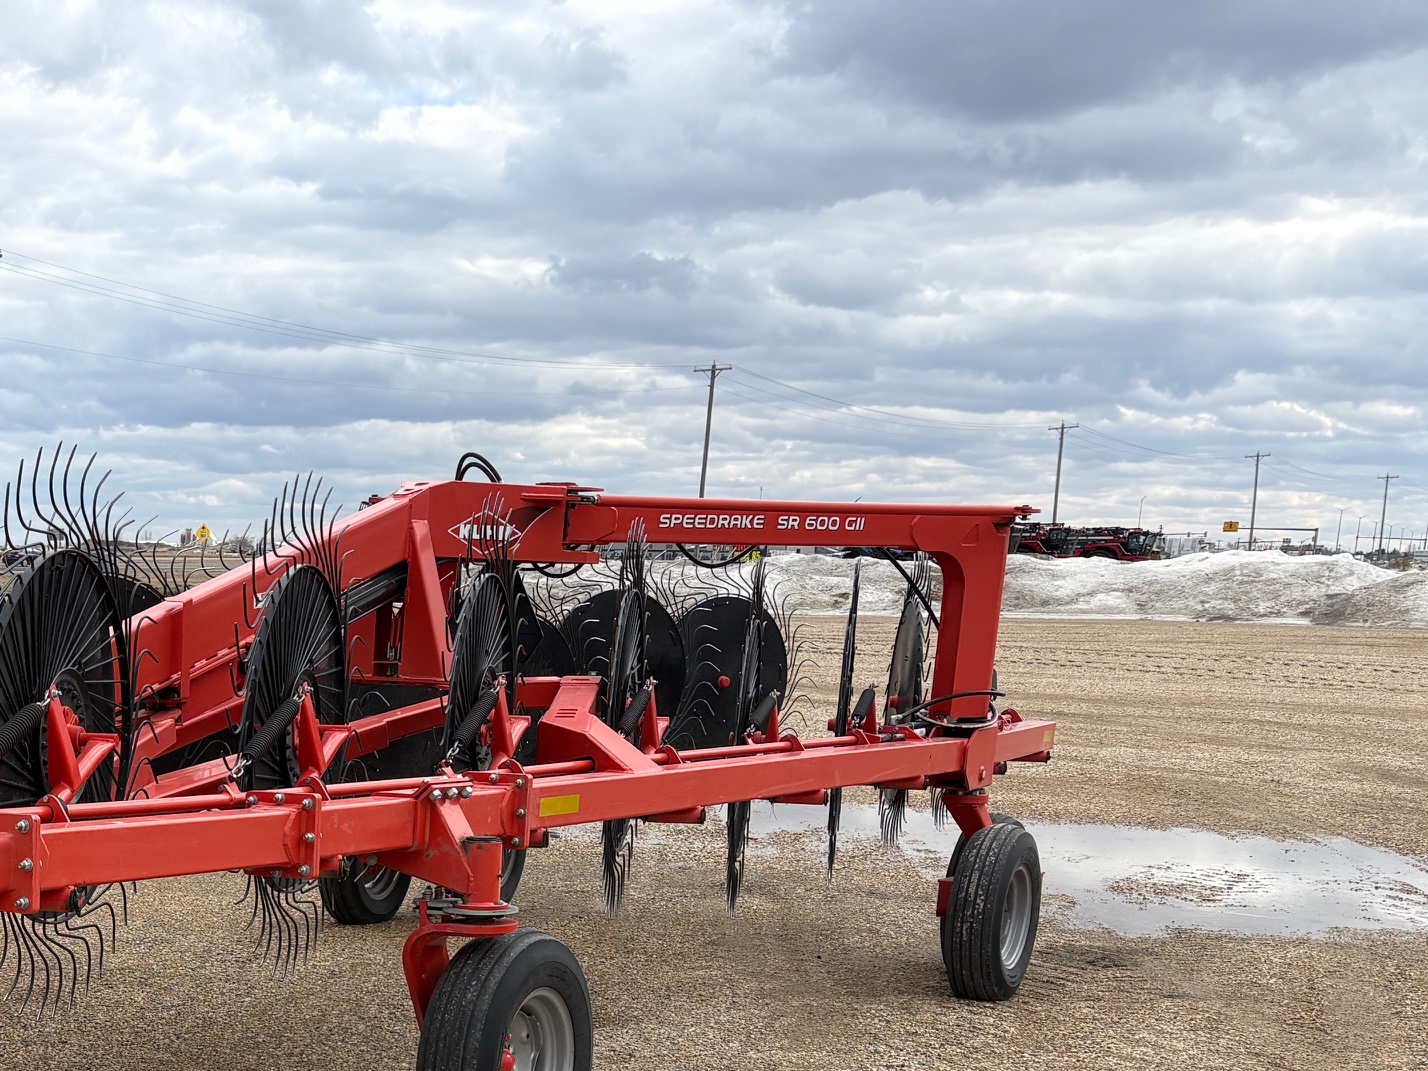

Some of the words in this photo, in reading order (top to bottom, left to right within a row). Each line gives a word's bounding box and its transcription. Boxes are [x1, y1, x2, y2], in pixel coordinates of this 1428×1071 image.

[658, 514, 765, 529] SPEEDRAKE
[777, 516, 800, 530] SR
[804, 516, 840, 531] 600
